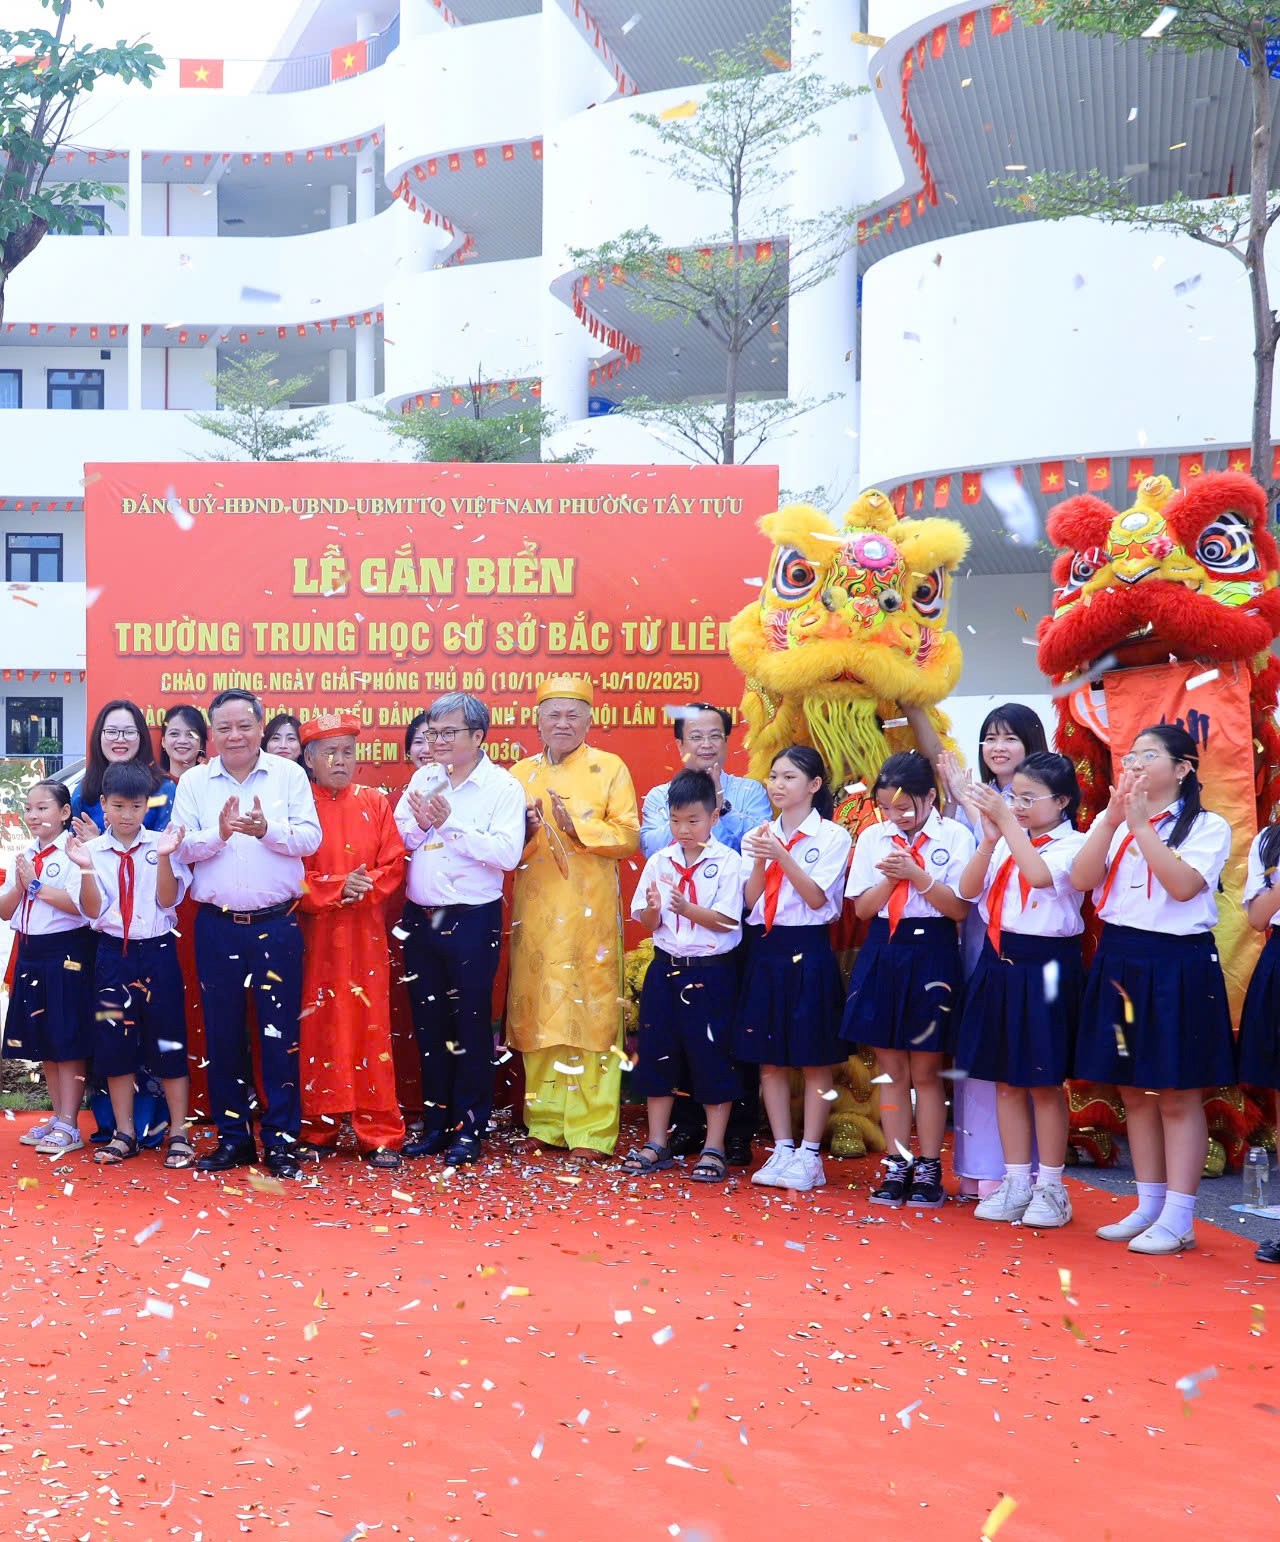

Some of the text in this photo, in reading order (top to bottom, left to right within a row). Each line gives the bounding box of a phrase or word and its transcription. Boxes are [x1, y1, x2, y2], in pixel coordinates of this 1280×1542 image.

[451, 496, 502, 519] VIỆT
[505, 497, 554, 515] NAM
[558, 494, 649, 515] PHƯỜNG
[653, 493, 695, 515] TÂY
[700, 497, 744, 519] TỰU
[292, 541, 576, 594] LỄ GẮN BIỂN
[115, 615, 241, 652] TRƯỜNG
[252, 621, 357, 652] TRUNG
[368, 621, 431, 658] HỌC
[443, 619, 486, 652] CƠ
[495, 612, 538, 652] SỞ
[548, 611, 611, 652] BẮC
[621, 615, 663, 652] TỪ
[161, 668, 207, 692] CHÀO
[213, 669, 265, 691] MỪNG
[270, 668, 315, 691] NGÀY
[321, 665, 355, 691] GIẢI
[362, 667, 419, 691] PHÓNG
[425, 666, 457, 691] THỦ
[463, 668, 485, 691] ĐÔ
[623, 700, 655, 725] LẦN
[355, 738, 398, 766] HIỆM
